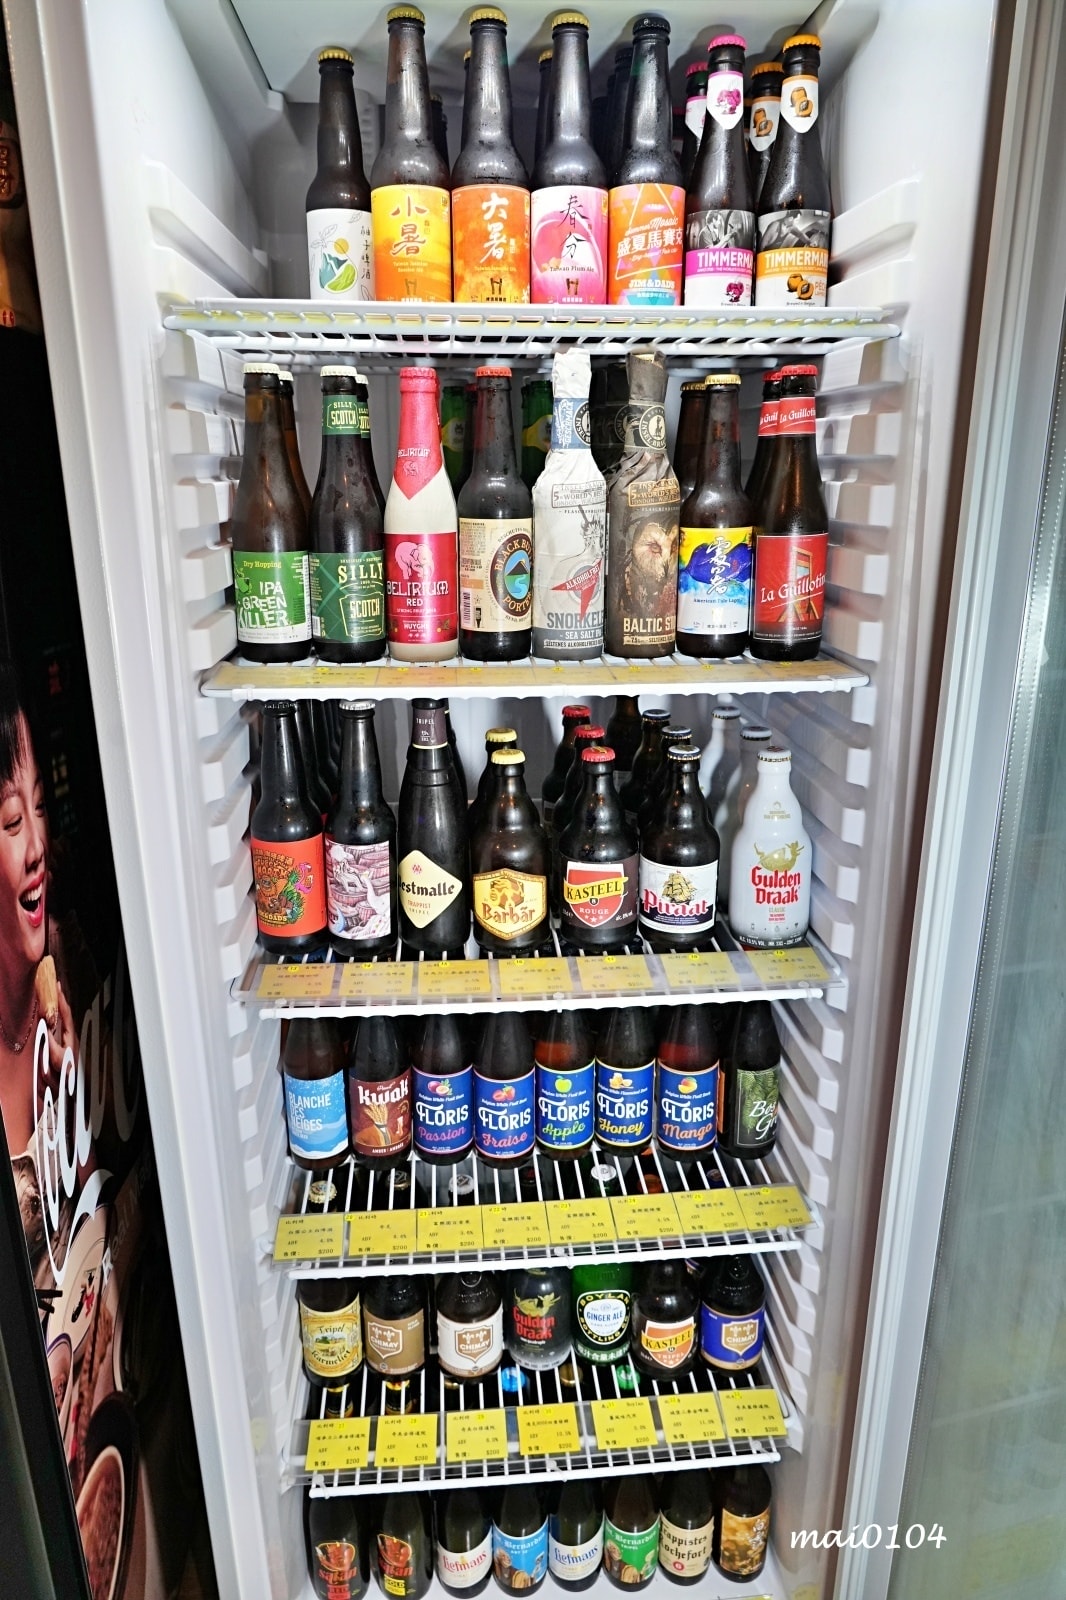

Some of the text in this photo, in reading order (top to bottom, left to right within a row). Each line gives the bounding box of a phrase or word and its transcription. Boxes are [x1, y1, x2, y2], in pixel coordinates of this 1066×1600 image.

[391, 195, 428, 256] 小暑
[480, 192, 509, 263] 大暑
[560, 194, 586, 259] 春分
[650, 215, 679, 231] Mosaic
[617, 227, 684, 259] 盛夏馬賽克
[331, 410, 357, 425] SCOTCH
[780, 414, 787, 423] La
[494, 538, 520, 571] BLACK
[243, 560, 282, 569] Dry Hopping
[337, 562, 383, 584] SILLY
[260, 581, 284, 596] IPA
[386, 581, 449, 596] DELIRIUM
[761, 588, 774, 603] La
[350, 598, 380, 619] SCOTCH
[406, 599, 423, 607] RED
[238, 610, 289, 629] KILLER
[623, 617, 662, 632] BALTIC
[580, 631, 594, 639] SALT
[751, 865, 801, 889] Gulden
[399, 881, 455, 896] estmalle
[566, 880, 622, 900] KASTEEL
[755, 887, 799, 906] Draak
[407, 900, 431, 909] TRAPPIST
[579, 907, 609, 915] ROUGE
[642, 888, 709, 916] Piraat
[288, 1091, 332, 1109] BLANCHE
[538, 1097, 590, 1121] FLORIS
[597, 1092, 648, 1119] FLORIS
[290, 1106, 304, 1119] DES
[416, 1102, 469, 1126] FLORIS
[478, 1106, 531, 1131] FLORIS
[661, 1097, 714, 1123] FLORIS
[291, 1118, 323, 1131] NEIGES
[418, 1126, 466, 1141] Passion
[542, 1121, 586, 1141] Apple
[598, 1118, 645, 1136] Honey
[662, 1123, 713, 1141] Mango
[482, 1132, 528, 1148] Fraise
[580, 1292, 629, 1306] BOYLAN
[512, 1306, 556, 1328] Gulden
[587, 1310, 623, 1321] GINGER ALE
[516, 1324, 553, 1340] Draak
[580, 1317, 620, 1341] BOTTLING
[726, 1333, 755, 1343] CHIMAY
[370, 1335, 399, 1349] CHIMAY
[459, 1339, 490, 1351] CHIMAY
[645, 1330, 691, 1349] KASTEEL
[442, 1550, 487, 1572] Liefmans
[554, 1545, 598, 1565] Liefmans
